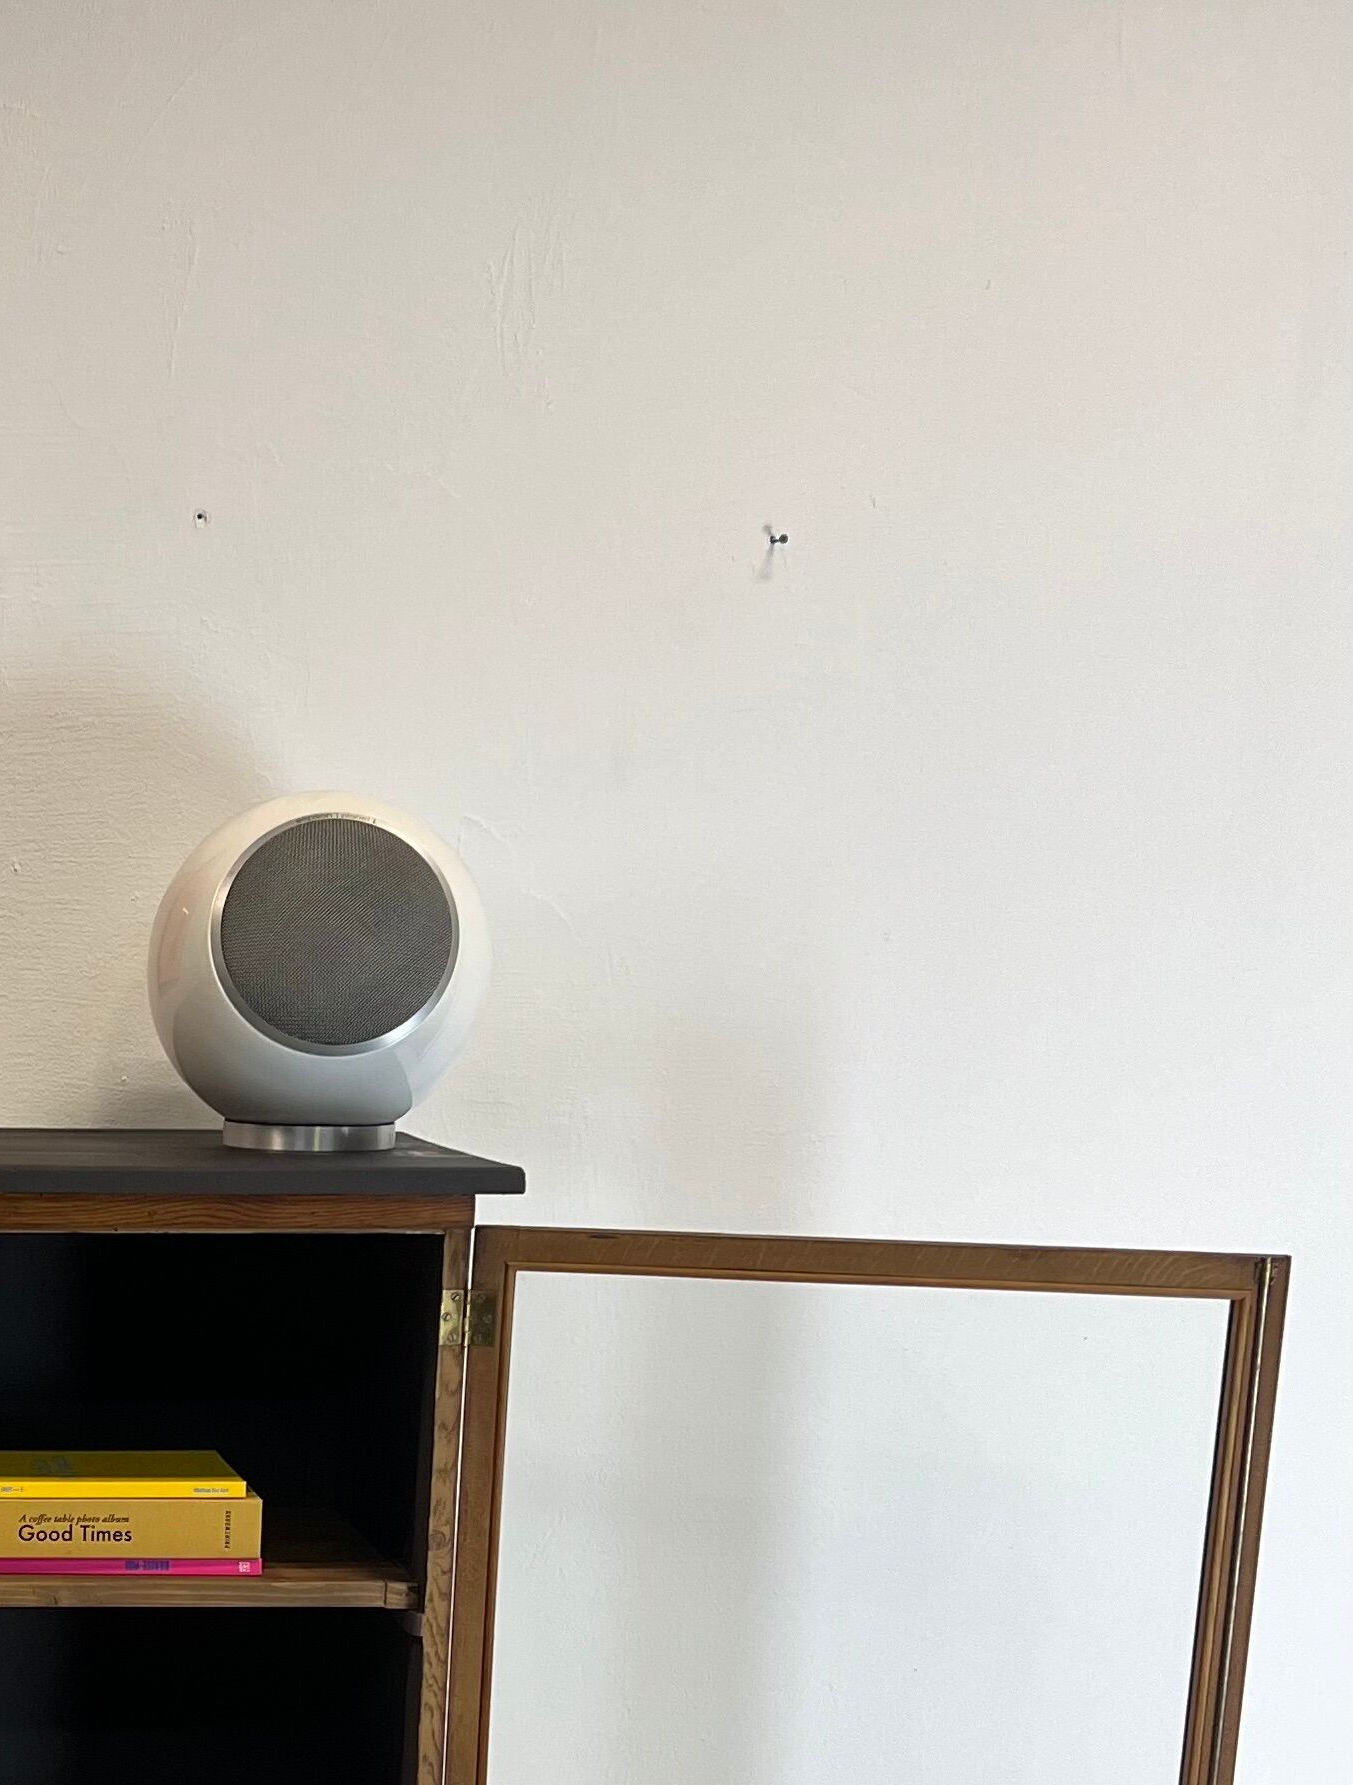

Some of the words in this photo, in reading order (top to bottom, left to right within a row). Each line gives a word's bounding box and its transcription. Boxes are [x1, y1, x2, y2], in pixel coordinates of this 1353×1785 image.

[18, 1514, 26, 1522] A
[29, 1514, 52, 1524] coffee
[54, 1514, 74, 1522] table
[76, 1514, 100, 1525] photo
[102, 1514, 129, 1522] album
[18, 1524, 72, 1541] Good
[80, 1525, 132, 1541] Times
